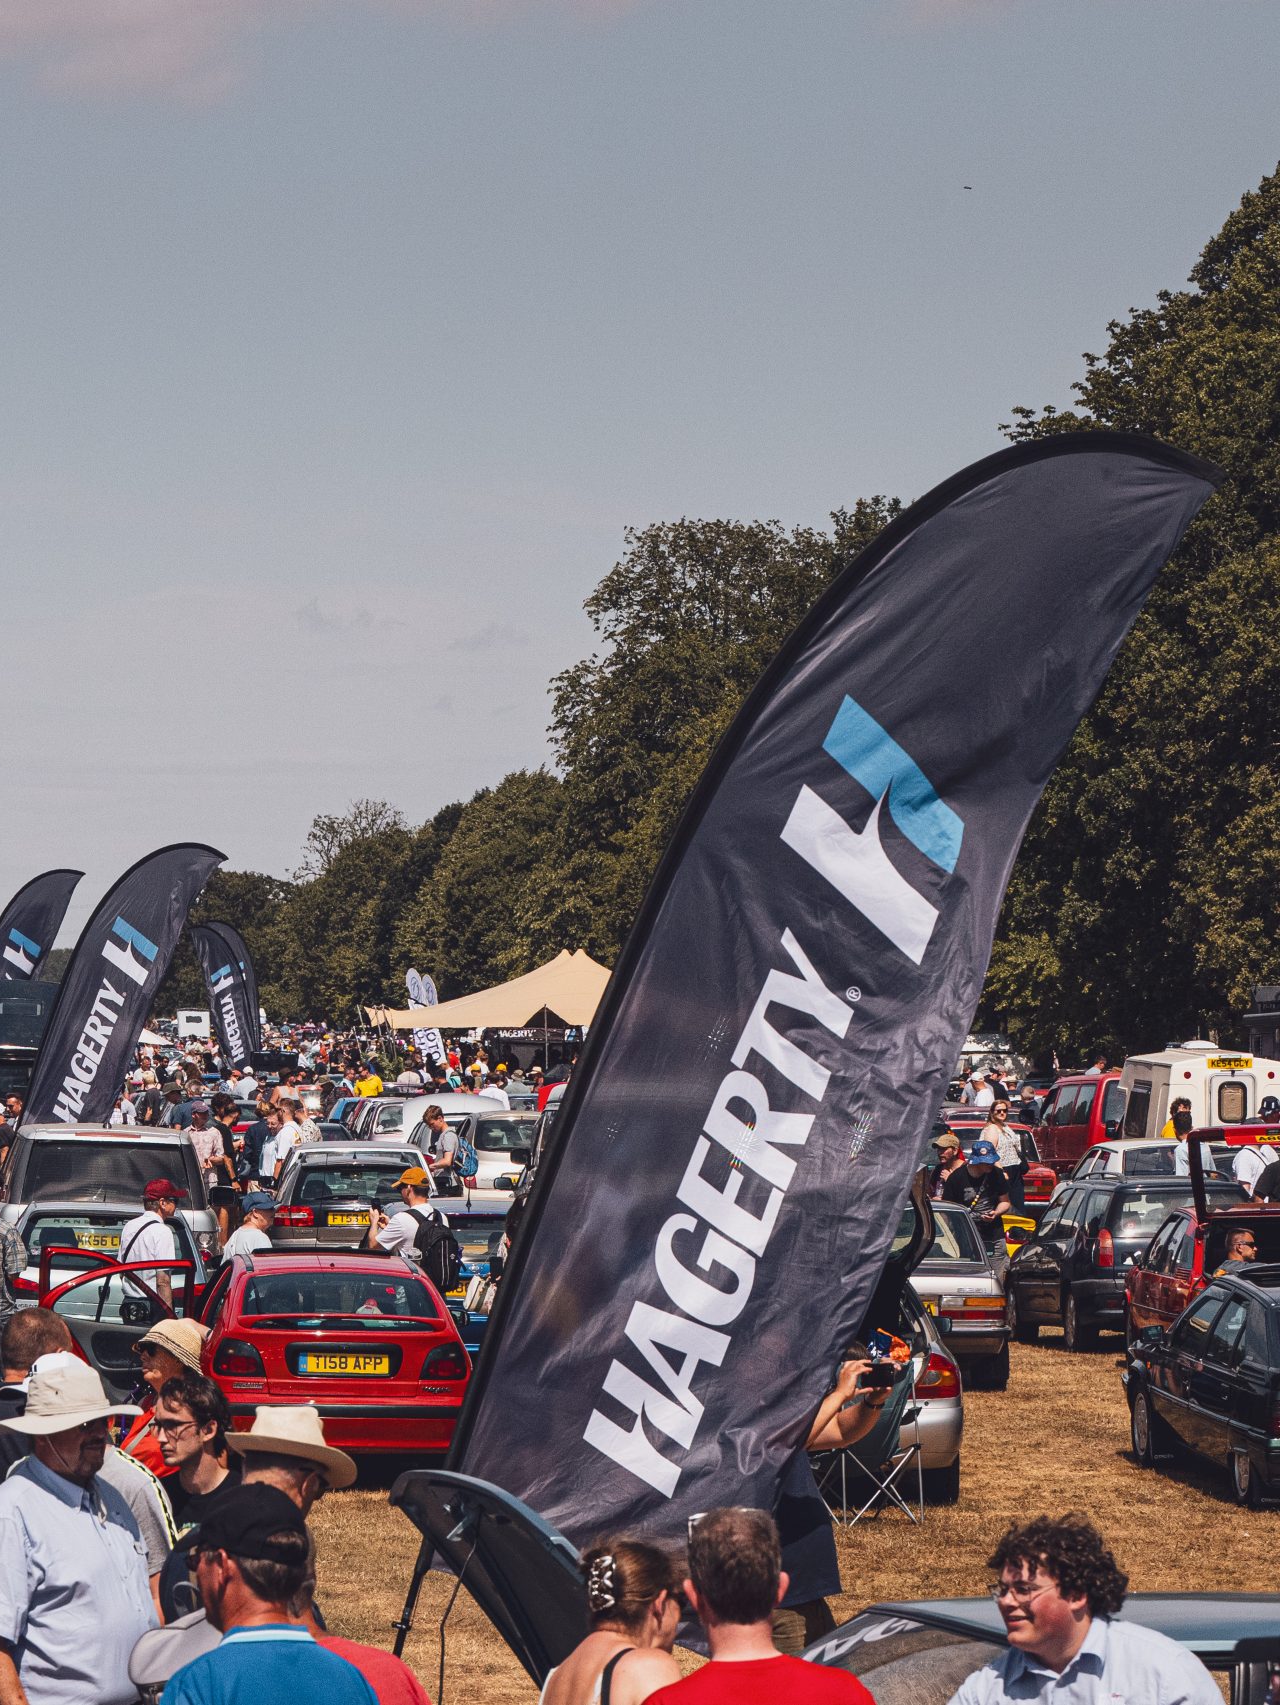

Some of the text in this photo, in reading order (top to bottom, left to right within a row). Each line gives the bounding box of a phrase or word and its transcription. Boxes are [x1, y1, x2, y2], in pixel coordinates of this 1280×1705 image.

[52, 978, 126, 1124] HAGERTY
[332, 1213, 359, 1223] FT53
[316, 1356, 384, 1371] T158 APP
